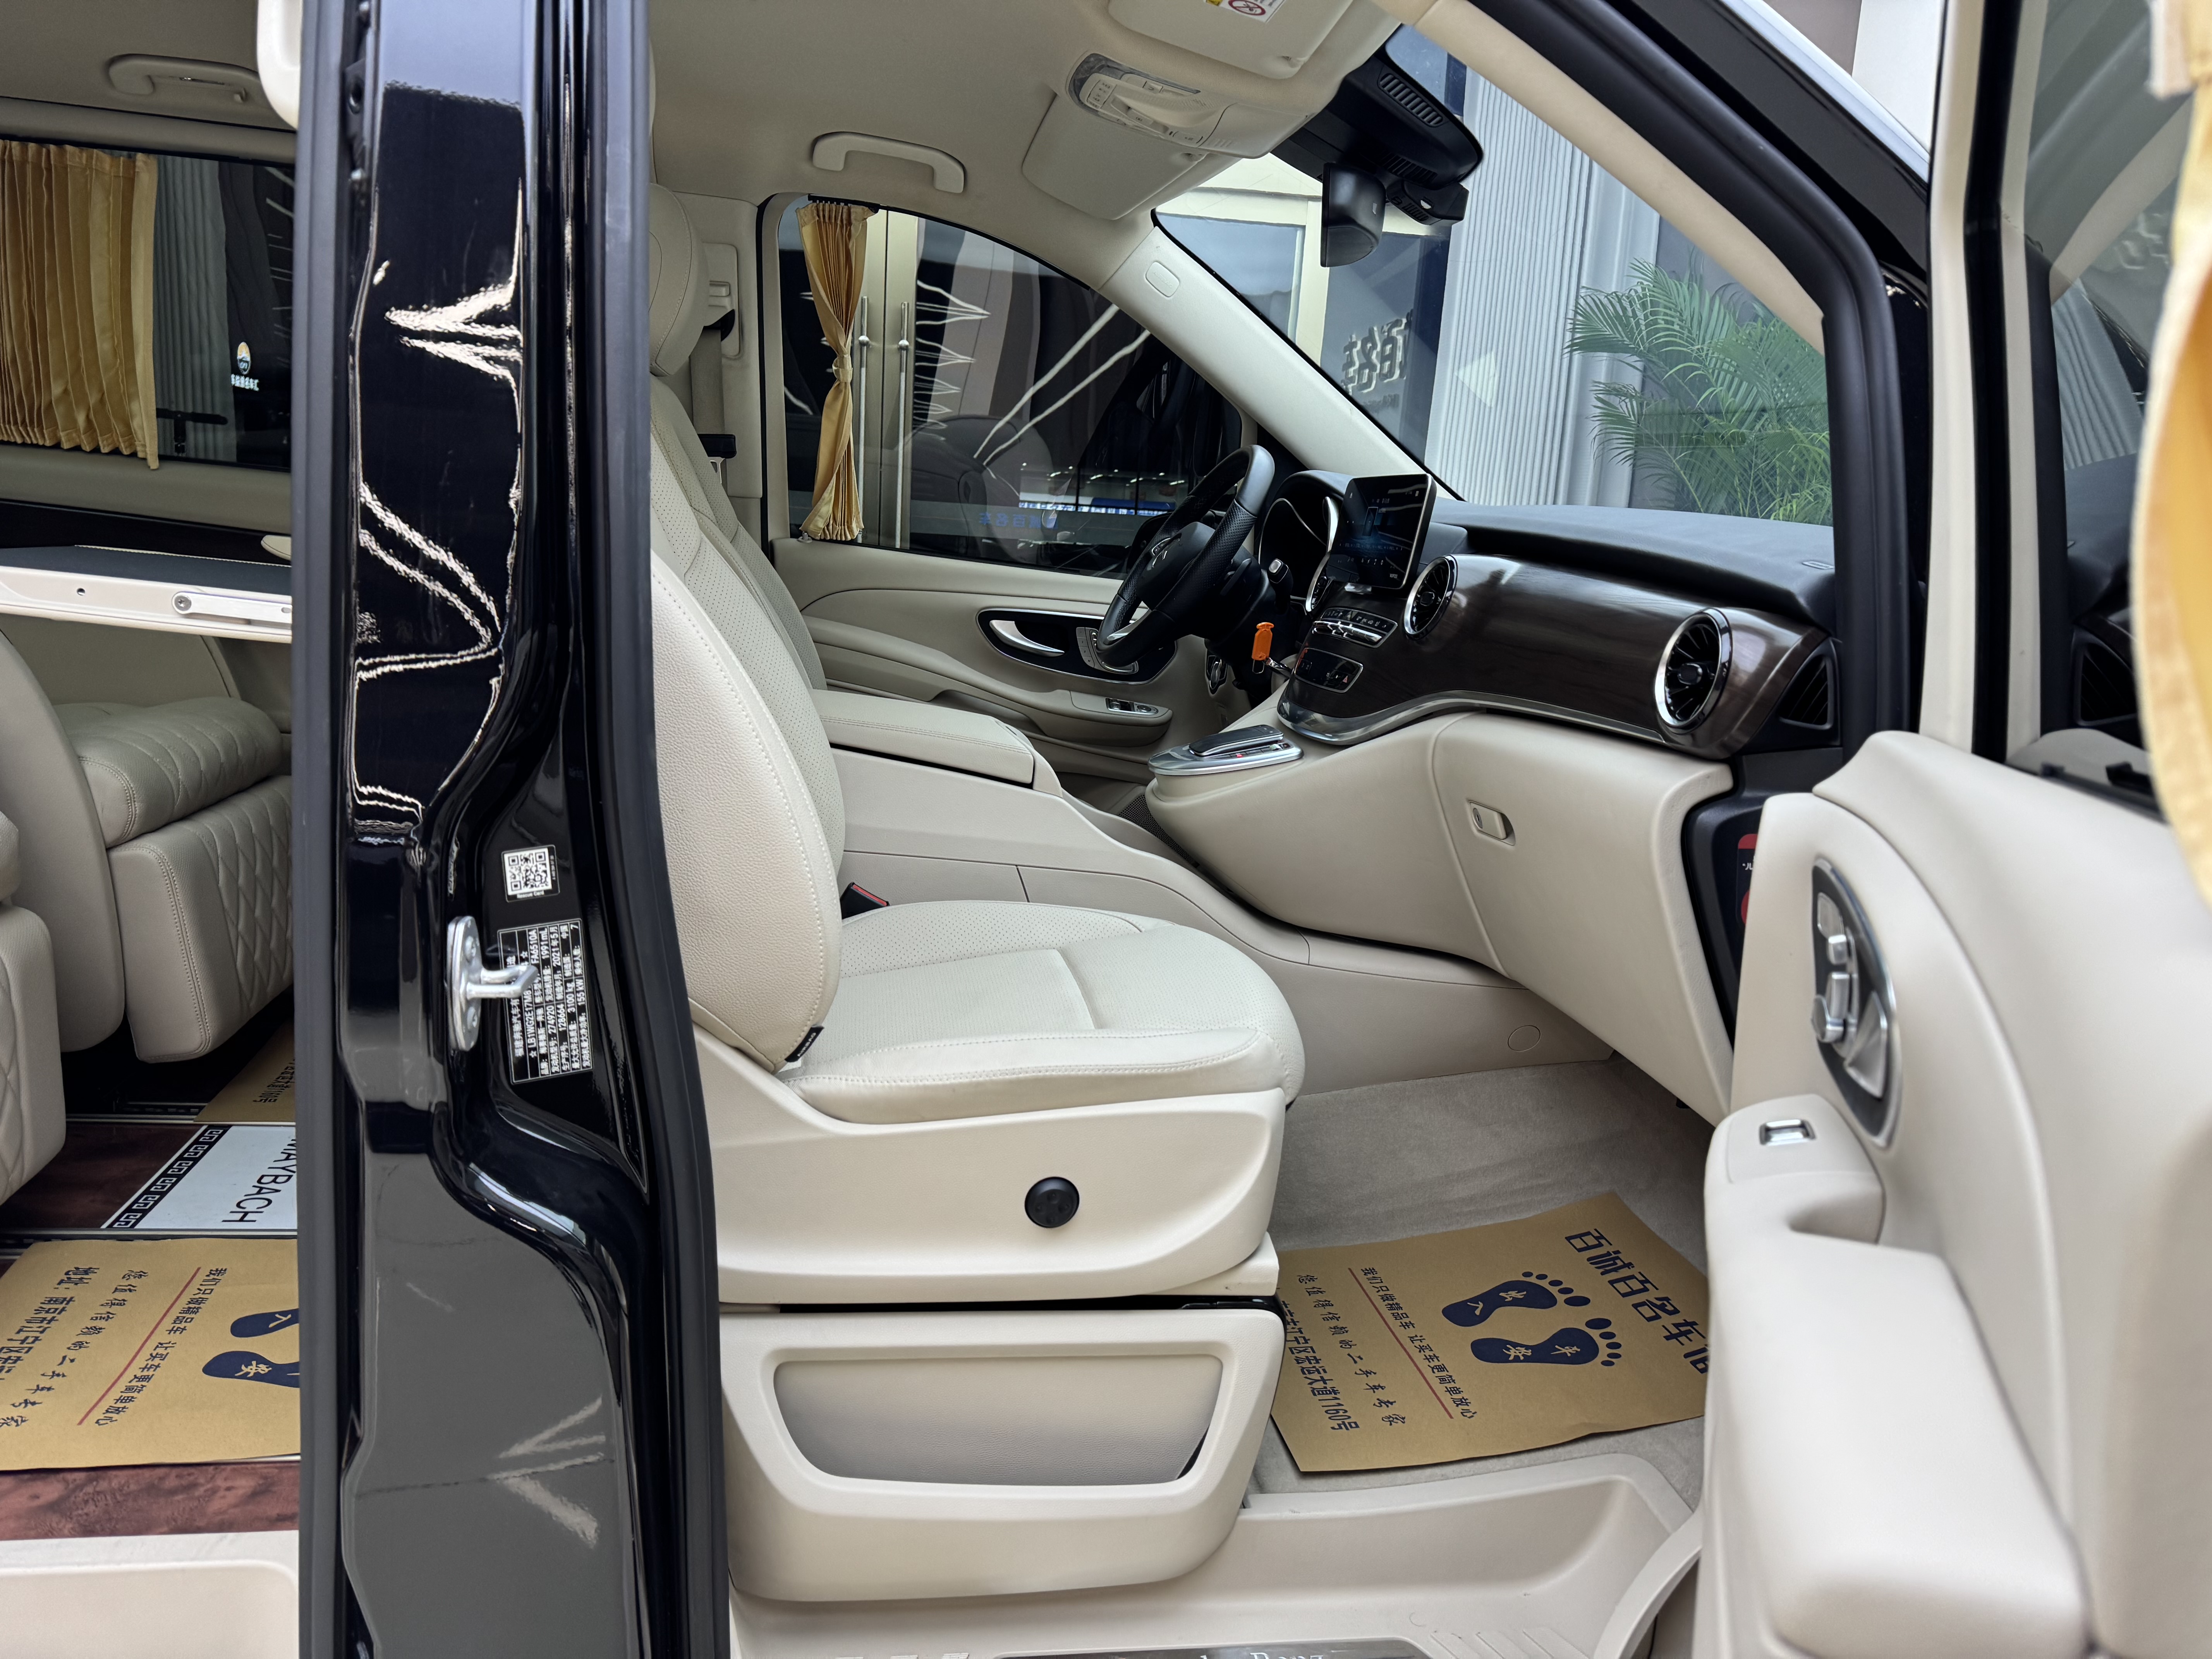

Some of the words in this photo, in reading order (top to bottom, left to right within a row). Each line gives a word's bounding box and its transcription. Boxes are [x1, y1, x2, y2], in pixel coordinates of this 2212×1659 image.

[528, 929, 539, 964] FA6510A
[560, 925, 569, 939] 中国
[565, 982, 575, 993] kg
[575, 979, 584, 991] kW
[576, 992, 586, 1006] 155
[556, 1003, 567, 1031] 128664
[566, 993, 575, 1014] 3100
[546, 1005, 557, 1035] 274920
[166, 1267, 227, 1335] 我们只做精品车
[1297, 1274, 1406, 1426] 您值得信赖的二手车专家
[1360, 1267, 1415, 1330] 我们只做精品车
[1407, 1334, 1477, 1419] 让买车更简单放心
[94, 1341, 177, 1426] 让买车更简单放心
